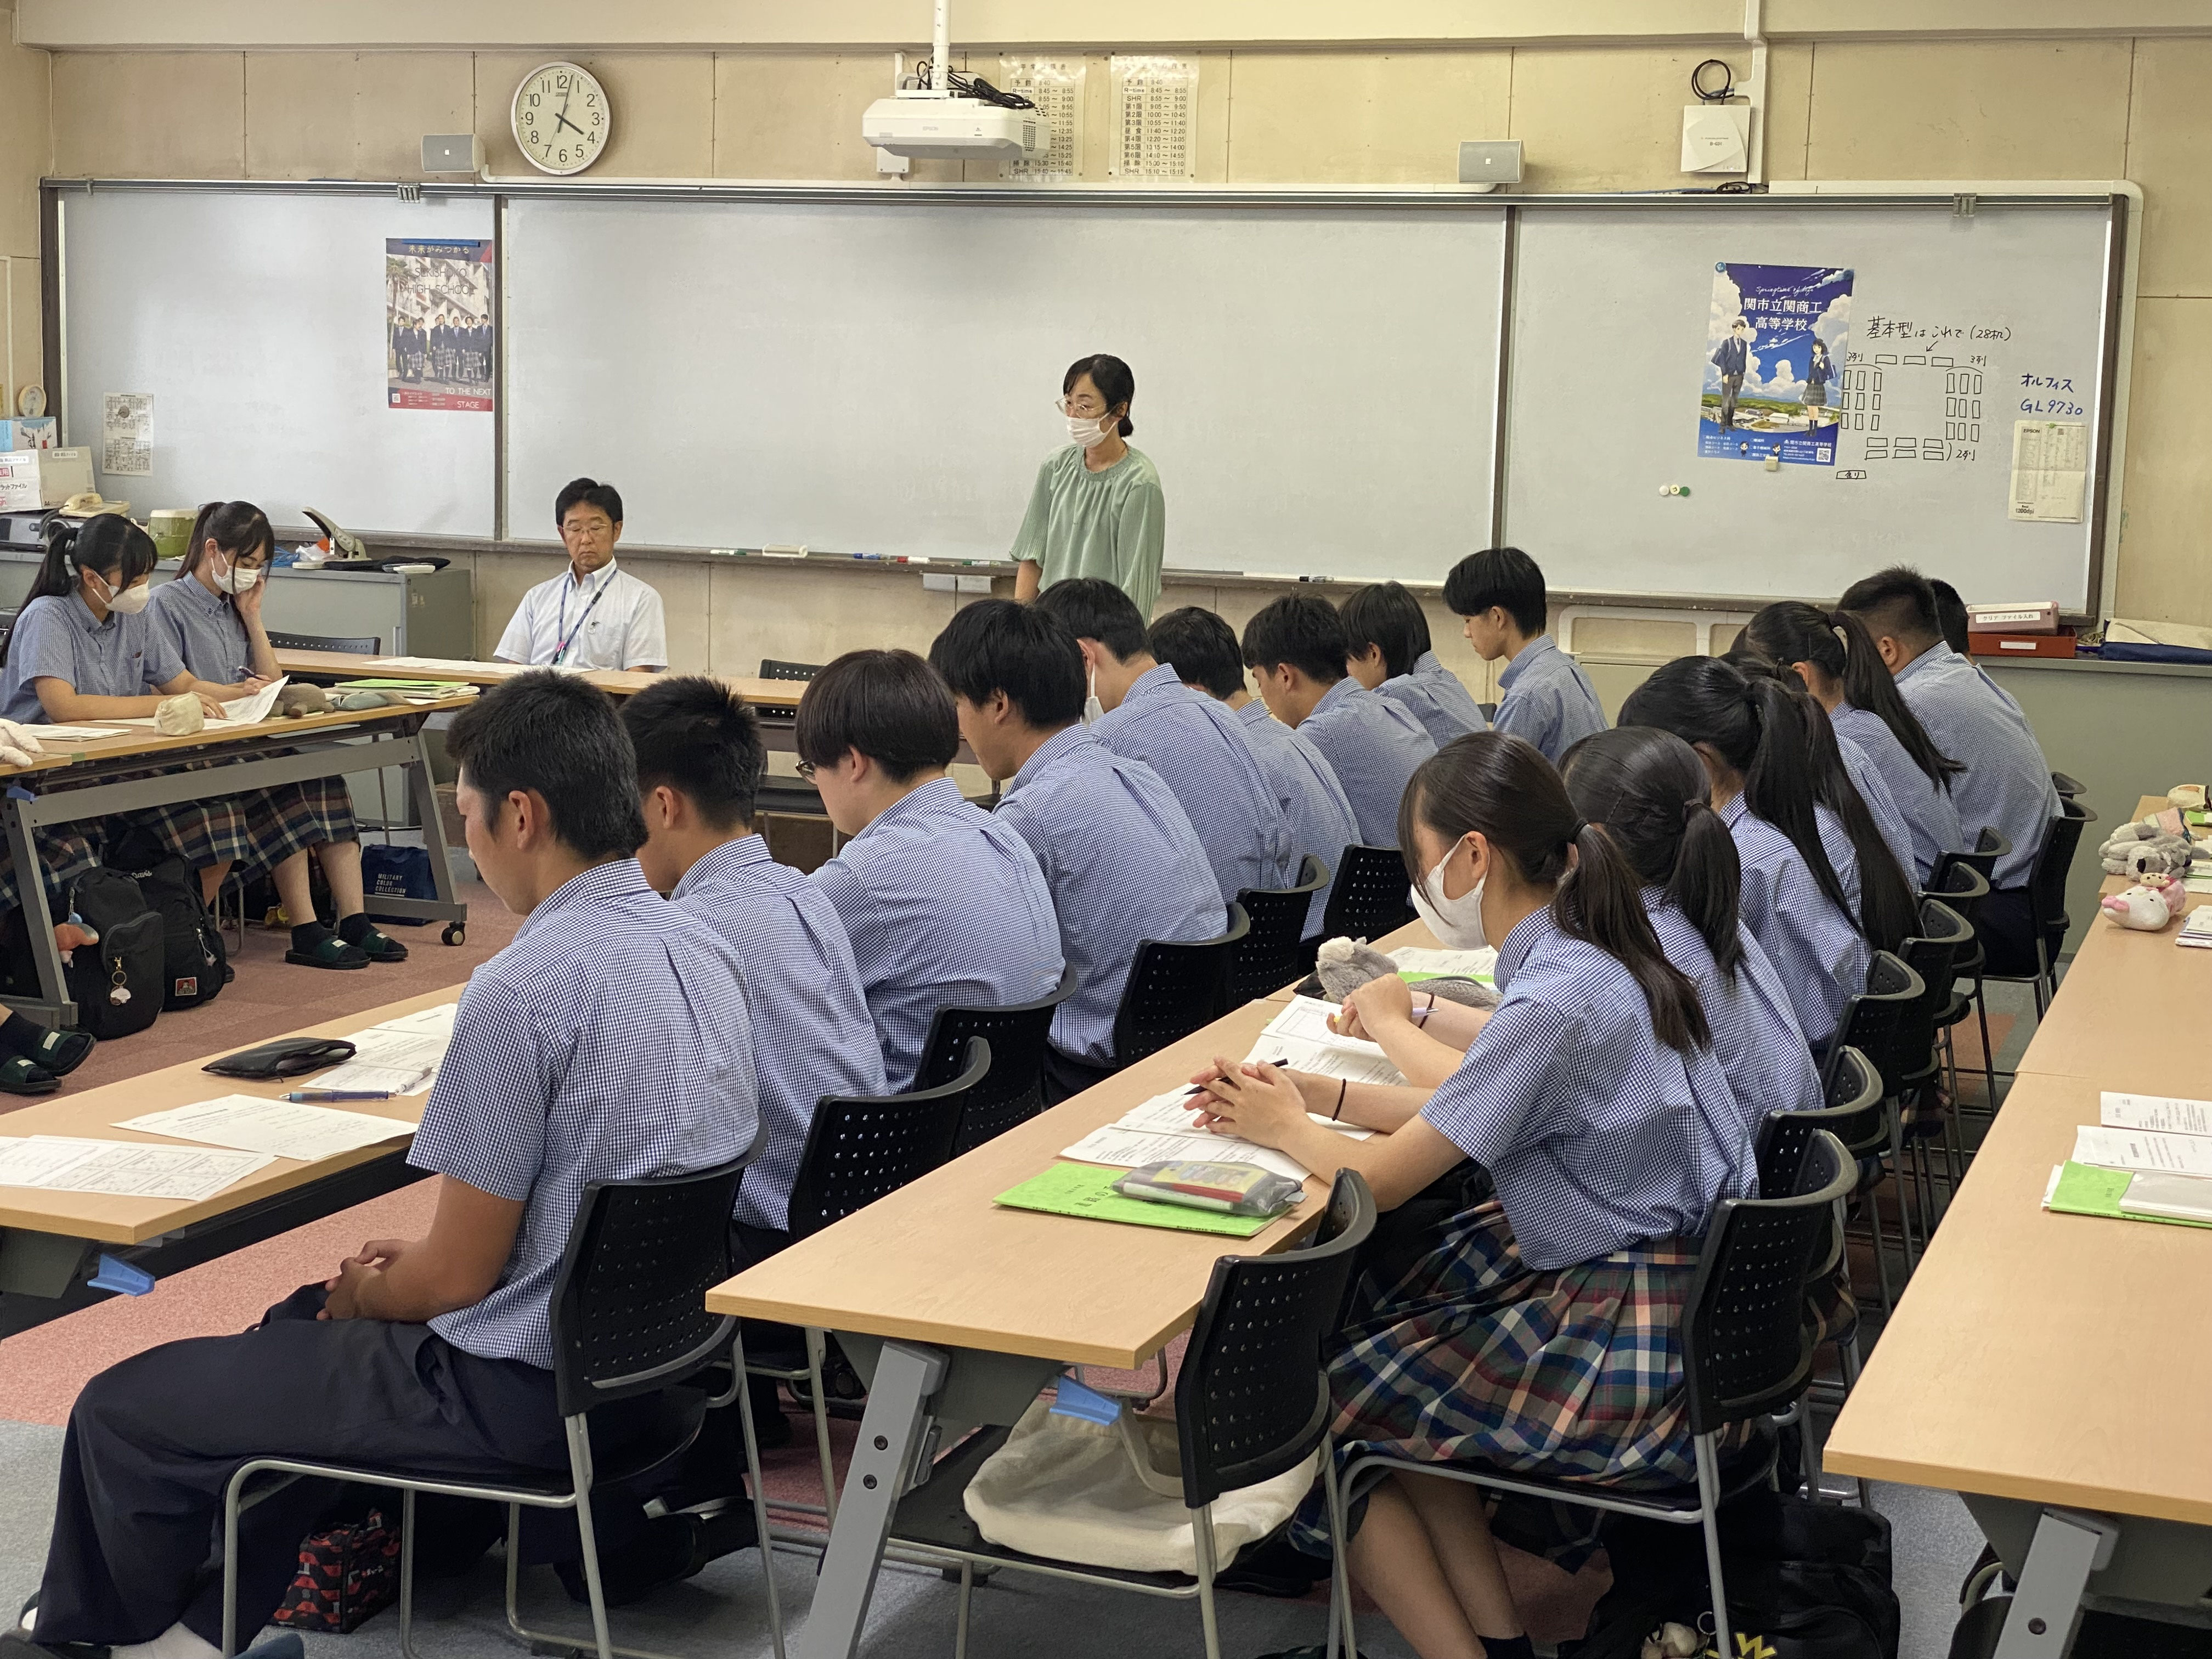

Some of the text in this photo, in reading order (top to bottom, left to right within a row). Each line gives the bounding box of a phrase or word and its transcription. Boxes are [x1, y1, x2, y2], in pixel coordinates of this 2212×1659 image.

[542, 80, 550, 93] 11
[557, 75, 568, 89] 12
[577, 80, 579, 93] 1
[530, 93, 540, 106] 10
[586, 94, 595, 107] 2
[525, 112, 534, 125] 9
[591, 112, 600, 126] 3
[531, 131, 539, 144] 8
[587, 131, 595, 144] 4
[544, 144, 552, 157] 7
[559, 149, 567, 162] 6
[575, 144, 584, 157] 5
[408, 285, 475, 296] HIGH SCHOOL
[1744, 298, 1822, 313] 関市立関商工
[1756, 316, 1808, 331] 高等学校
[1970, 355, 1987, 366] 3列
[2021, 373, 2074, 393] オルフィス
[1956, 449, 1975, 461] 2列
[375, 885, 406, 894] COLLECTION
